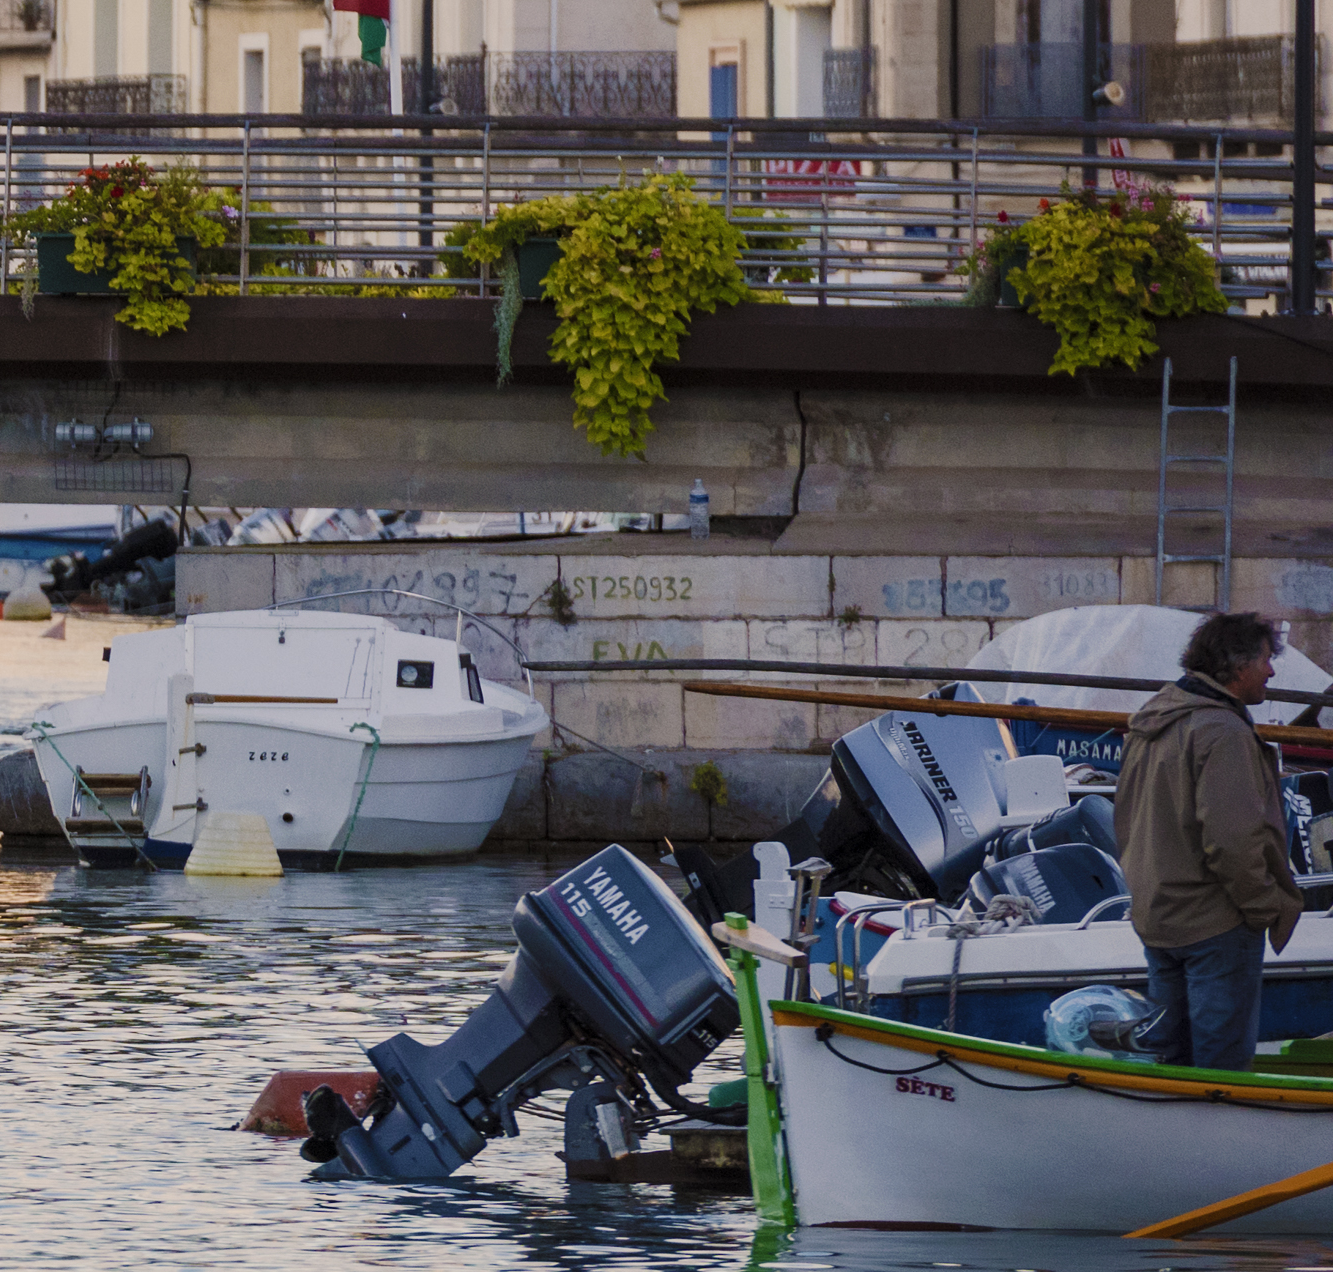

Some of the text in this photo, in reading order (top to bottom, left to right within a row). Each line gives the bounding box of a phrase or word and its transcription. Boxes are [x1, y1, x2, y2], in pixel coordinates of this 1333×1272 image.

[573, 576, 693, 602] ST250932
[949, 805, 980, 839] 150
[560, 882, 593, 918] 115
[1021, 859, 1056, 915] YAMAHA
[583, 865, 650, 946] YAMAHA
[895, 1075, 956, 1103] SÈTE
